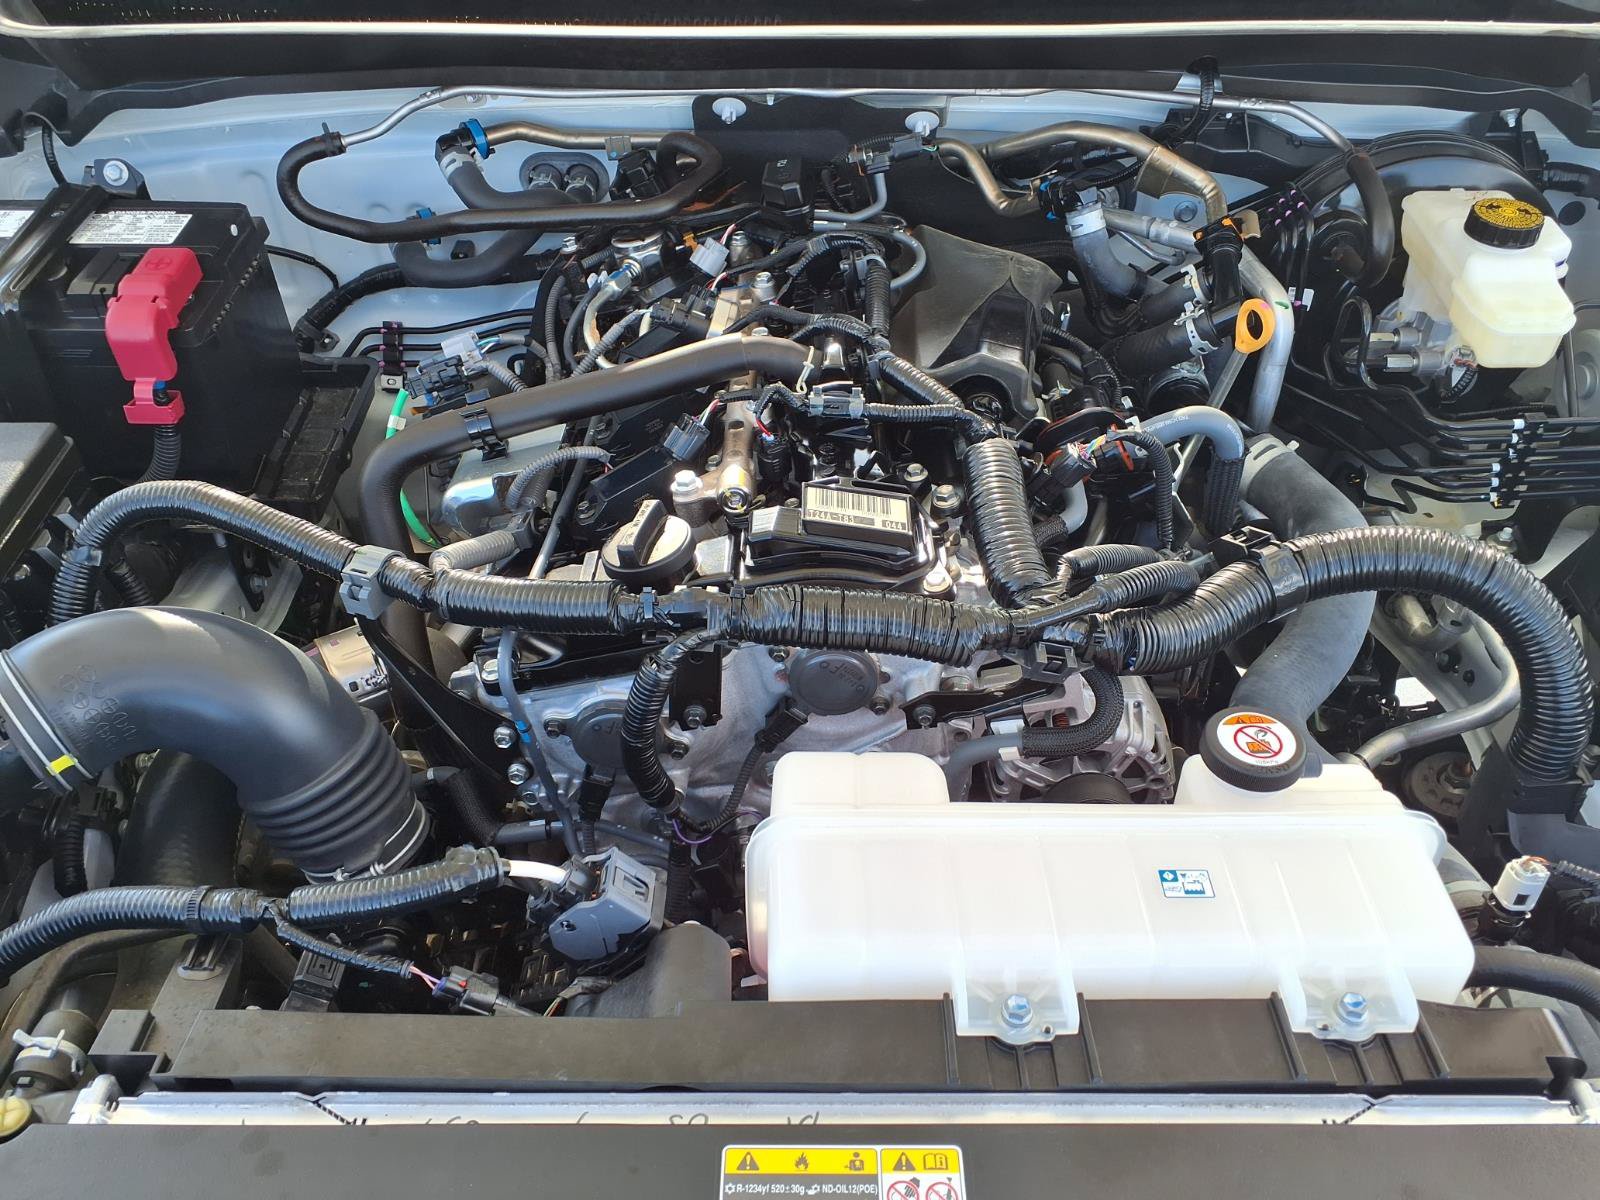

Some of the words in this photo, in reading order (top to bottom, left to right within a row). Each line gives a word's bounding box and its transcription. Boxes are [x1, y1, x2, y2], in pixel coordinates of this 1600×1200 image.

[736, 1183, 770, 1195] R-1234yf
[771, 1184, 805, 1195] 520±30g
[822, 1184, 878, 1195] ND-OIL12(POE)
